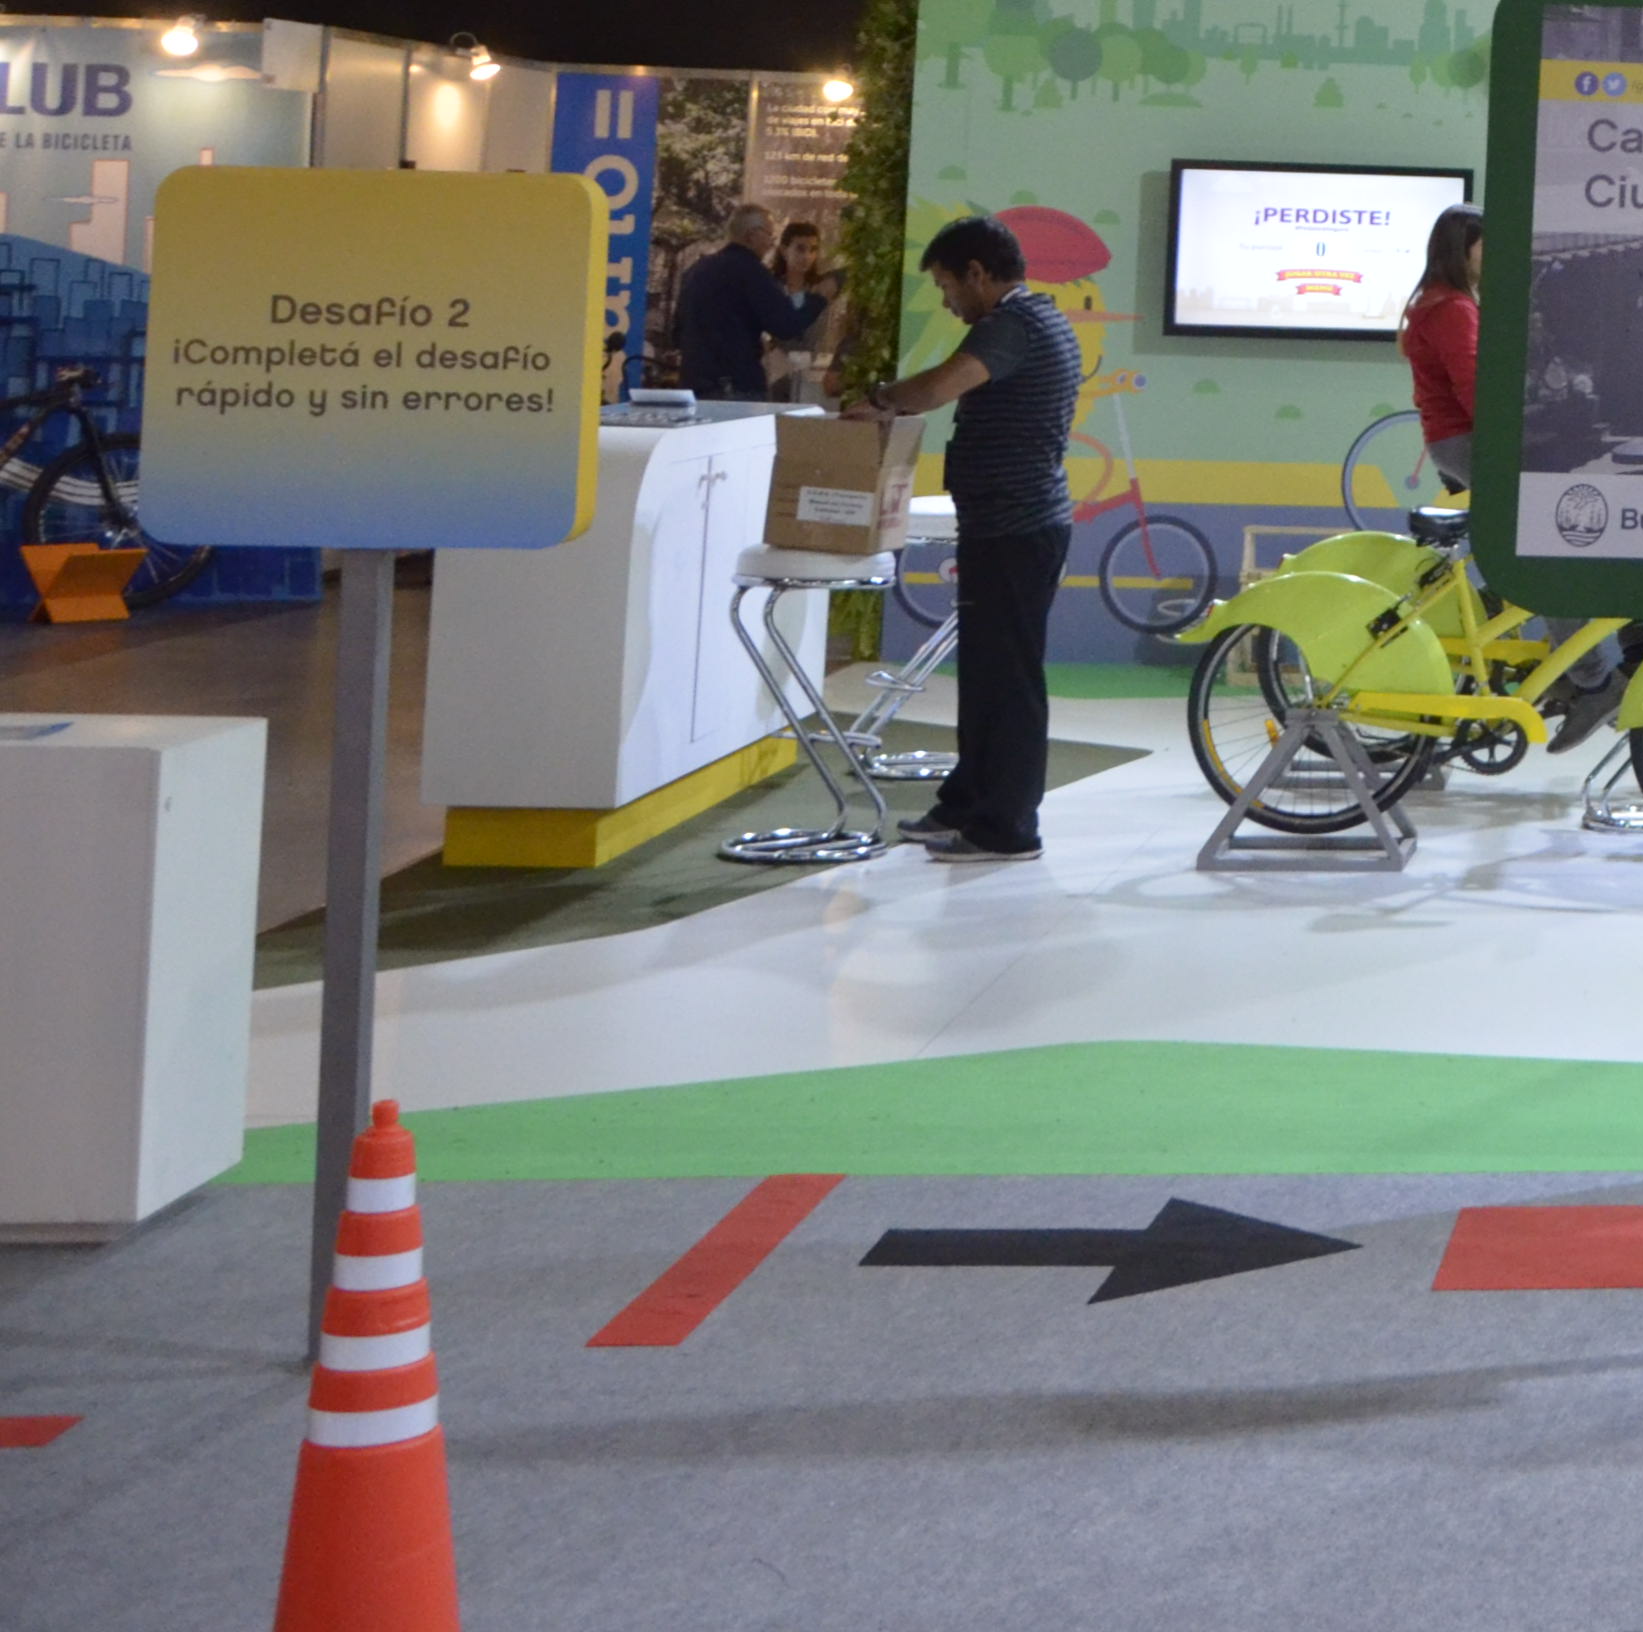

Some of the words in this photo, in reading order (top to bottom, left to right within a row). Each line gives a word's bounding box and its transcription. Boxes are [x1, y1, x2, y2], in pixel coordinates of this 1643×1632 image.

[14, 131, 35, 149] LA
[41, 132, 133, 151] BICICLETA
[1254, 207, 1391, 226] ¡PERDISTE!
[270, 294, 433, 328] Desafío
[447, 298, 470, 328] 2
[173, 338, 360, 374] ¡Completá
[373, 341, 403, 369] el
[415, 342, 551, 372] desafío
[176, 380, 295, 416] rápido
[308, 389, 327, 418] y
[341, 384, 389, 410] sin
[401, 388, 554, 413] errores!
